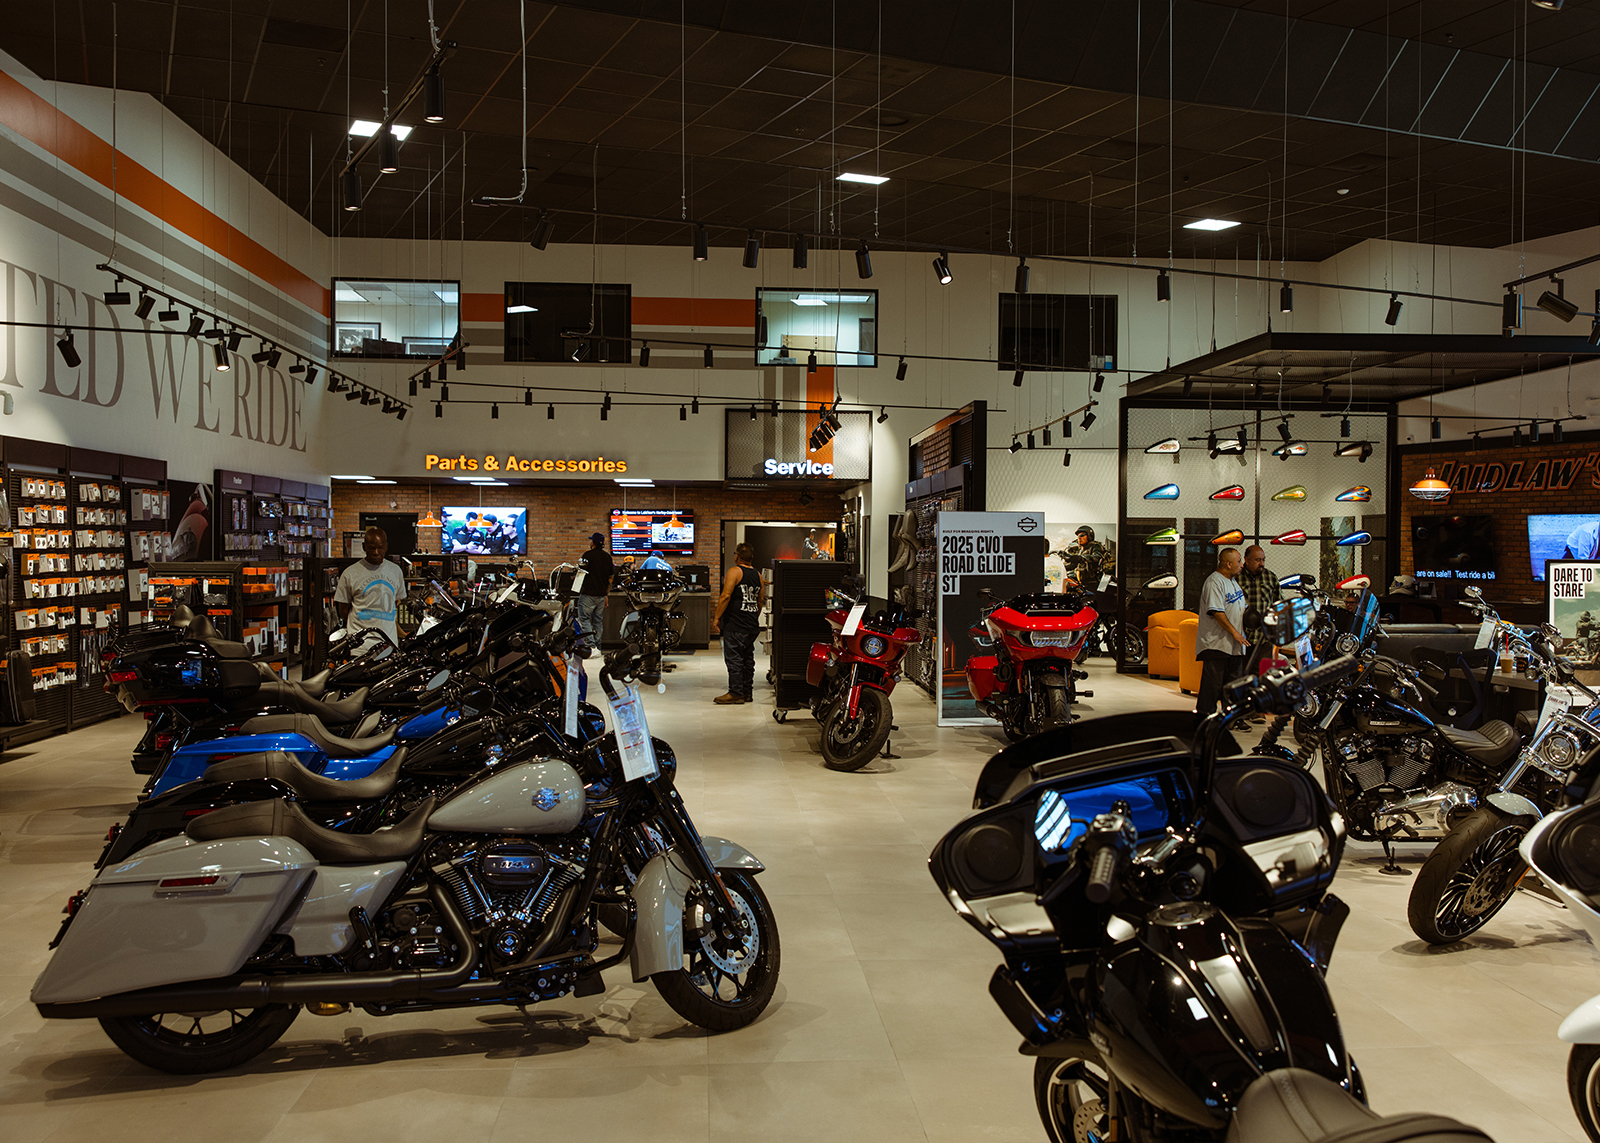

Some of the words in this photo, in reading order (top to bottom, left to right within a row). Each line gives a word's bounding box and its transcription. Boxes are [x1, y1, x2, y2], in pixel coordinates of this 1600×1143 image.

[141, 316, 220, 433] WE
[231, 351, 307, 452] RIDE
[425, 454, 479, 471] Parts
[483, 455, 500, 471] &
[505, 455, 628, 473] Accessories
[764, 458, 834, 475] Service
[942, 536, 973, 554] 2025
[976, 536, 1001, 554] CVO
[942, 555, 974, 573] ROAD
[977, 555, 1013, 573] GLIDE
[1455, 570, 1468, 578] Test
[1469, 570, 1481, 579] ride
[1554, 568, 1578, 582] DARE
[1580, 568, 1592, 582] TO
[942, 575, 958, 593] ST
[1554, 583, 1584, 597] STARE
